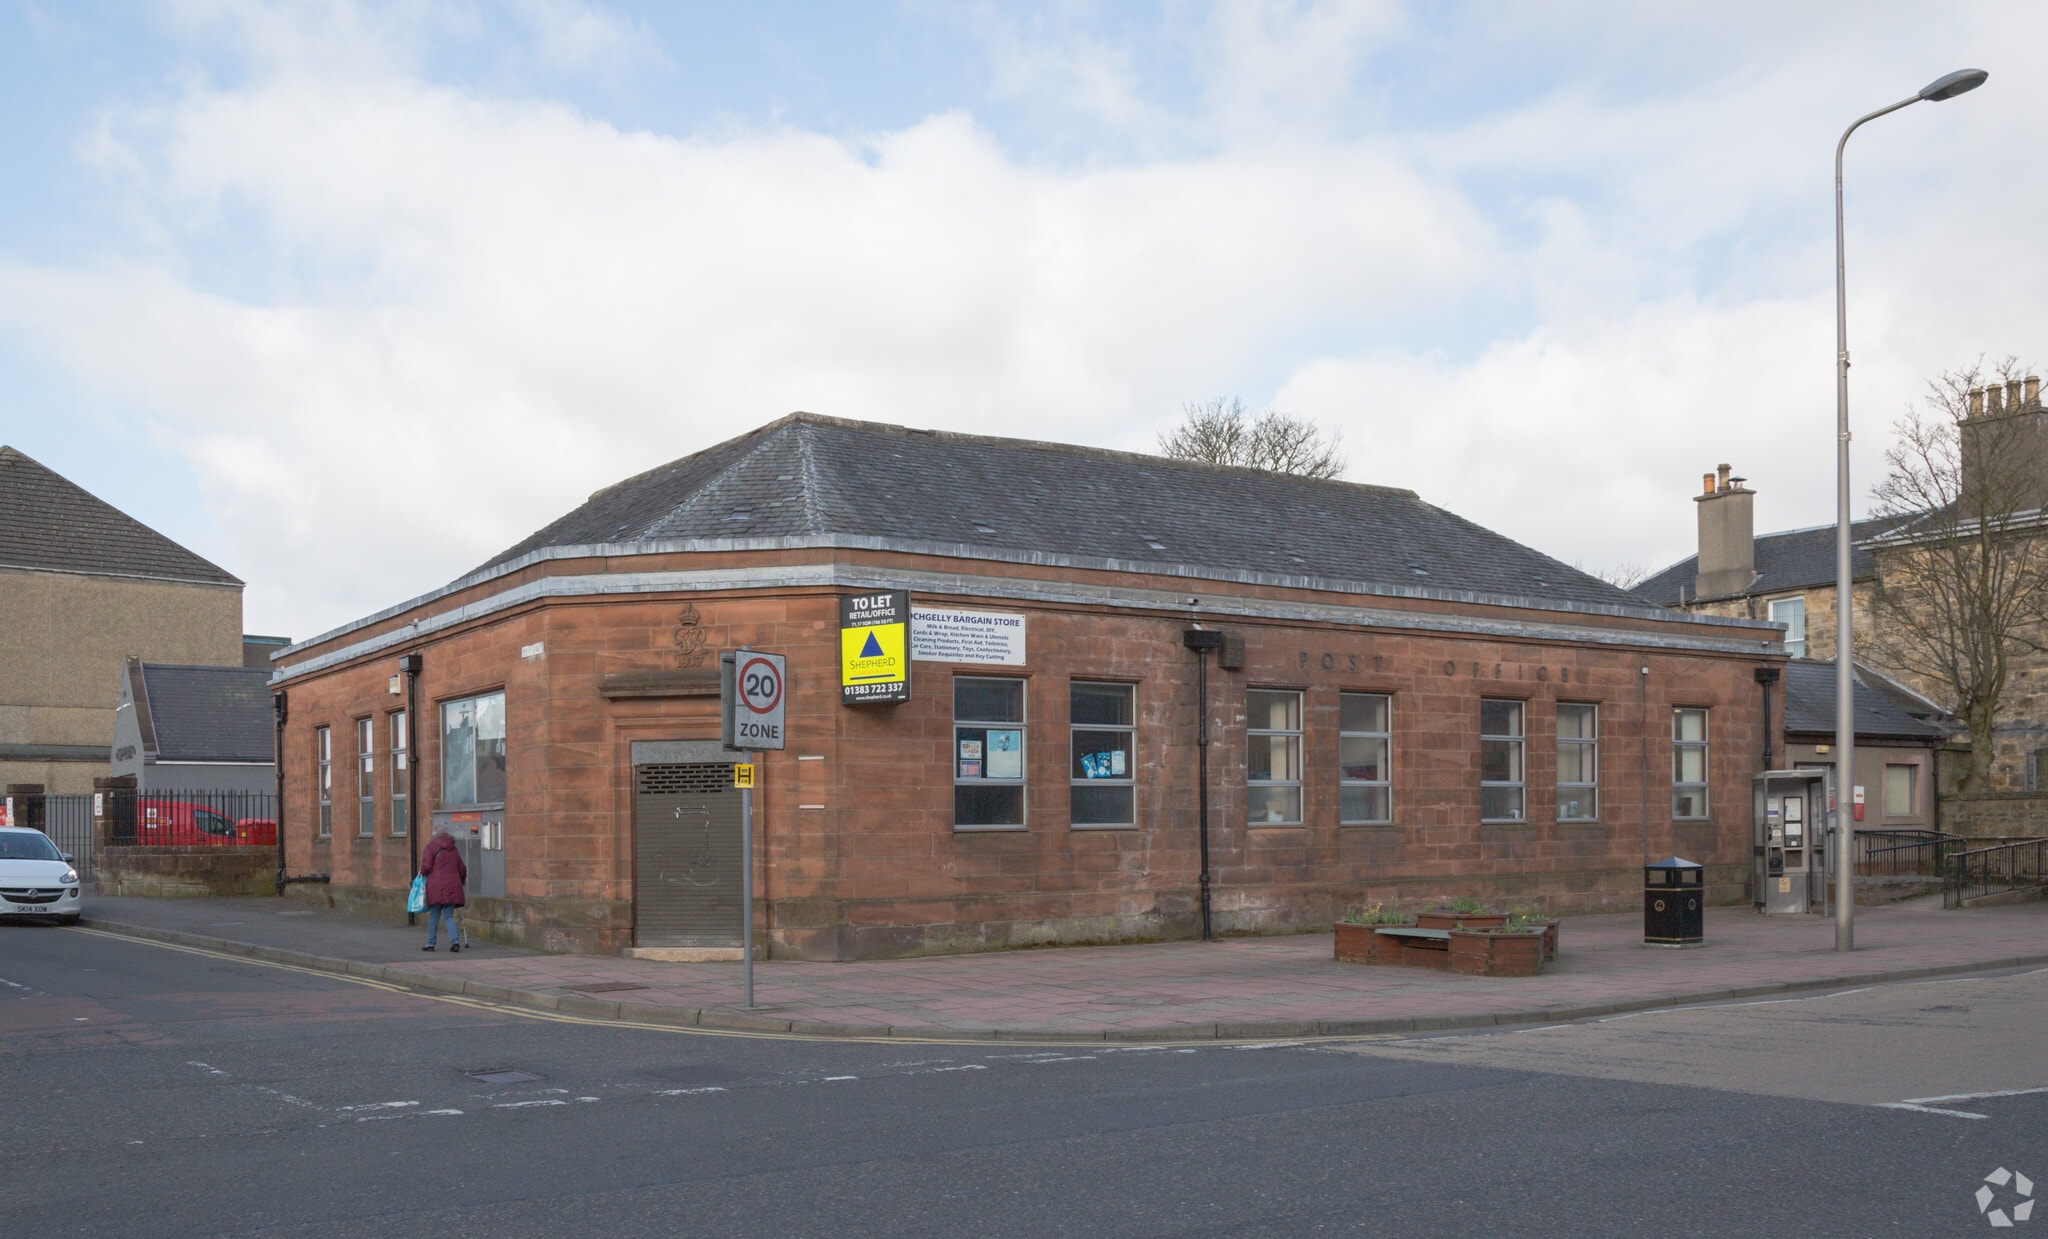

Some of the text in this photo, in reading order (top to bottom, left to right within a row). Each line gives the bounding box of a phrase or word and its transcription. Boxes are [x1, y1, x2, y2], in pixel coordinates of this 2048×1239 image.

[852, 595, 892, 610] TO LET
[849, 608, 895, 620] RETAIL/OFFICE
[910, 612, 1020, 627] CHGELLY BARGAIN STORE
[677, 655, 704, 668] 1937
[1299, 652, 1570, 683] POST OFFICE
[746, 673, 775, 698] 20
[845, 683, 903, 695] 01383 722 337
[740, 723, 779, 739] ZONE
[738, 766, 751, 785] H
